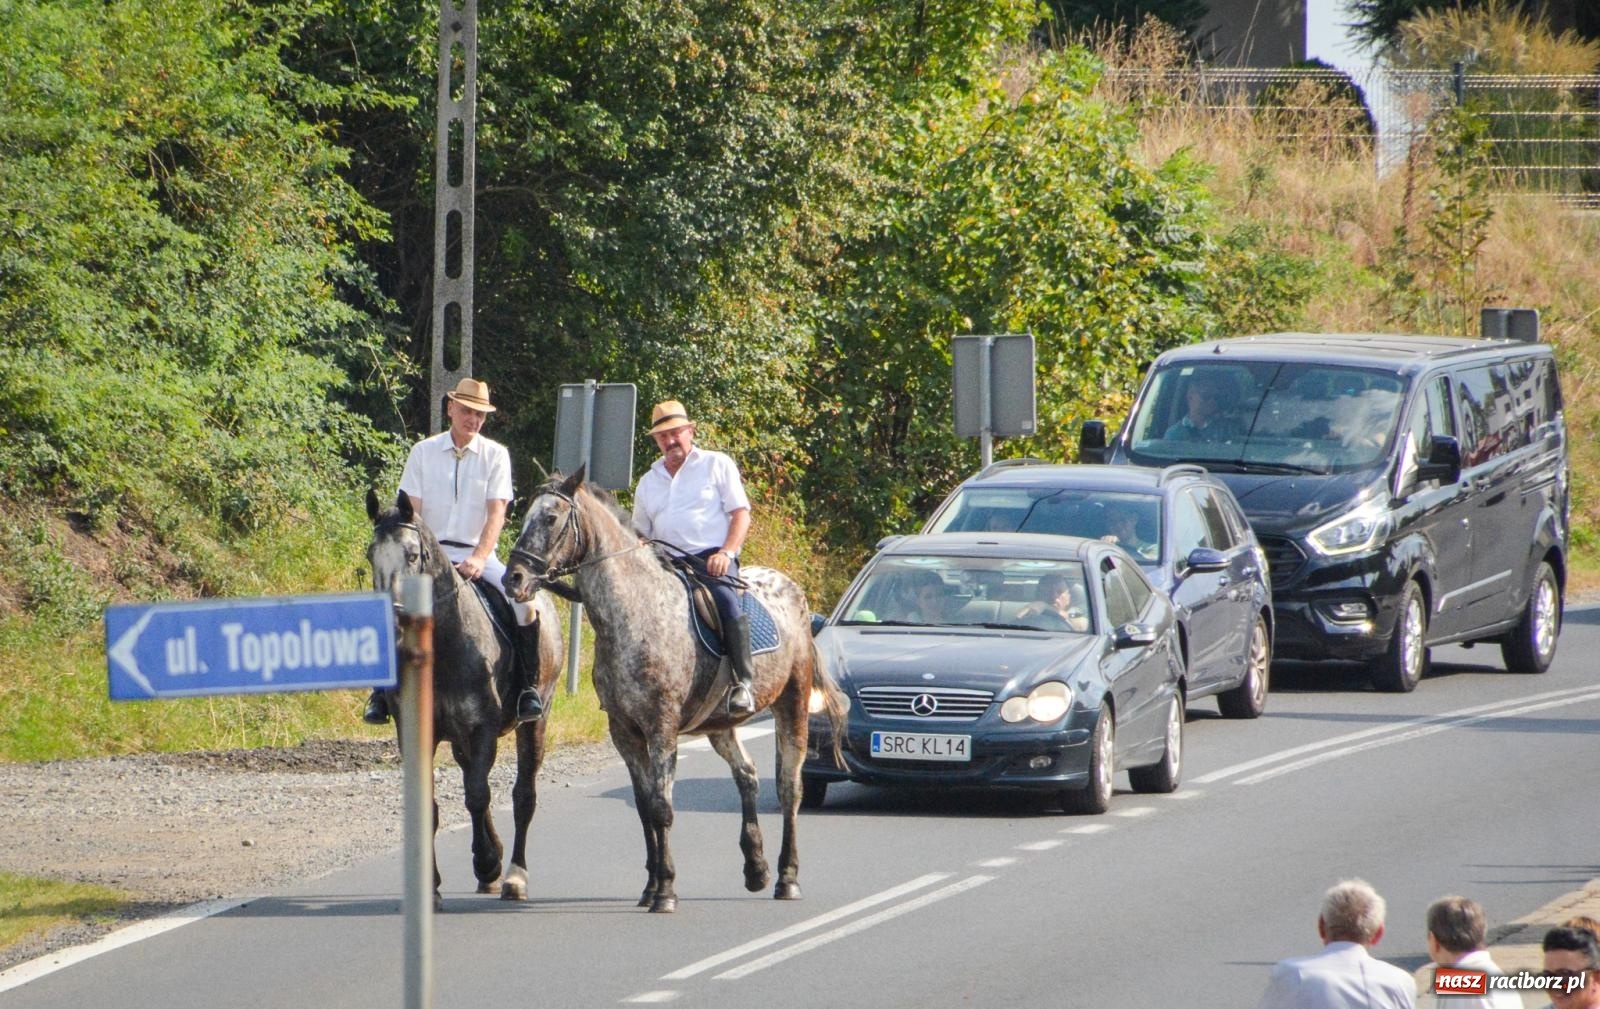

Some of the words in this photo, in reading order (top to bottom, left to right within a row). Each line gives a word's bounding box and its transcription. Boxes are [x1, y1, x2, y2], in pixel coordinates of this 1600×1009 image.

[165, 625, 209, 676] ul.
[221, 619, 380, 682] Topolowa
[883, 736, 915, 753] SRC
[922, 738, 965, 755] KL14
